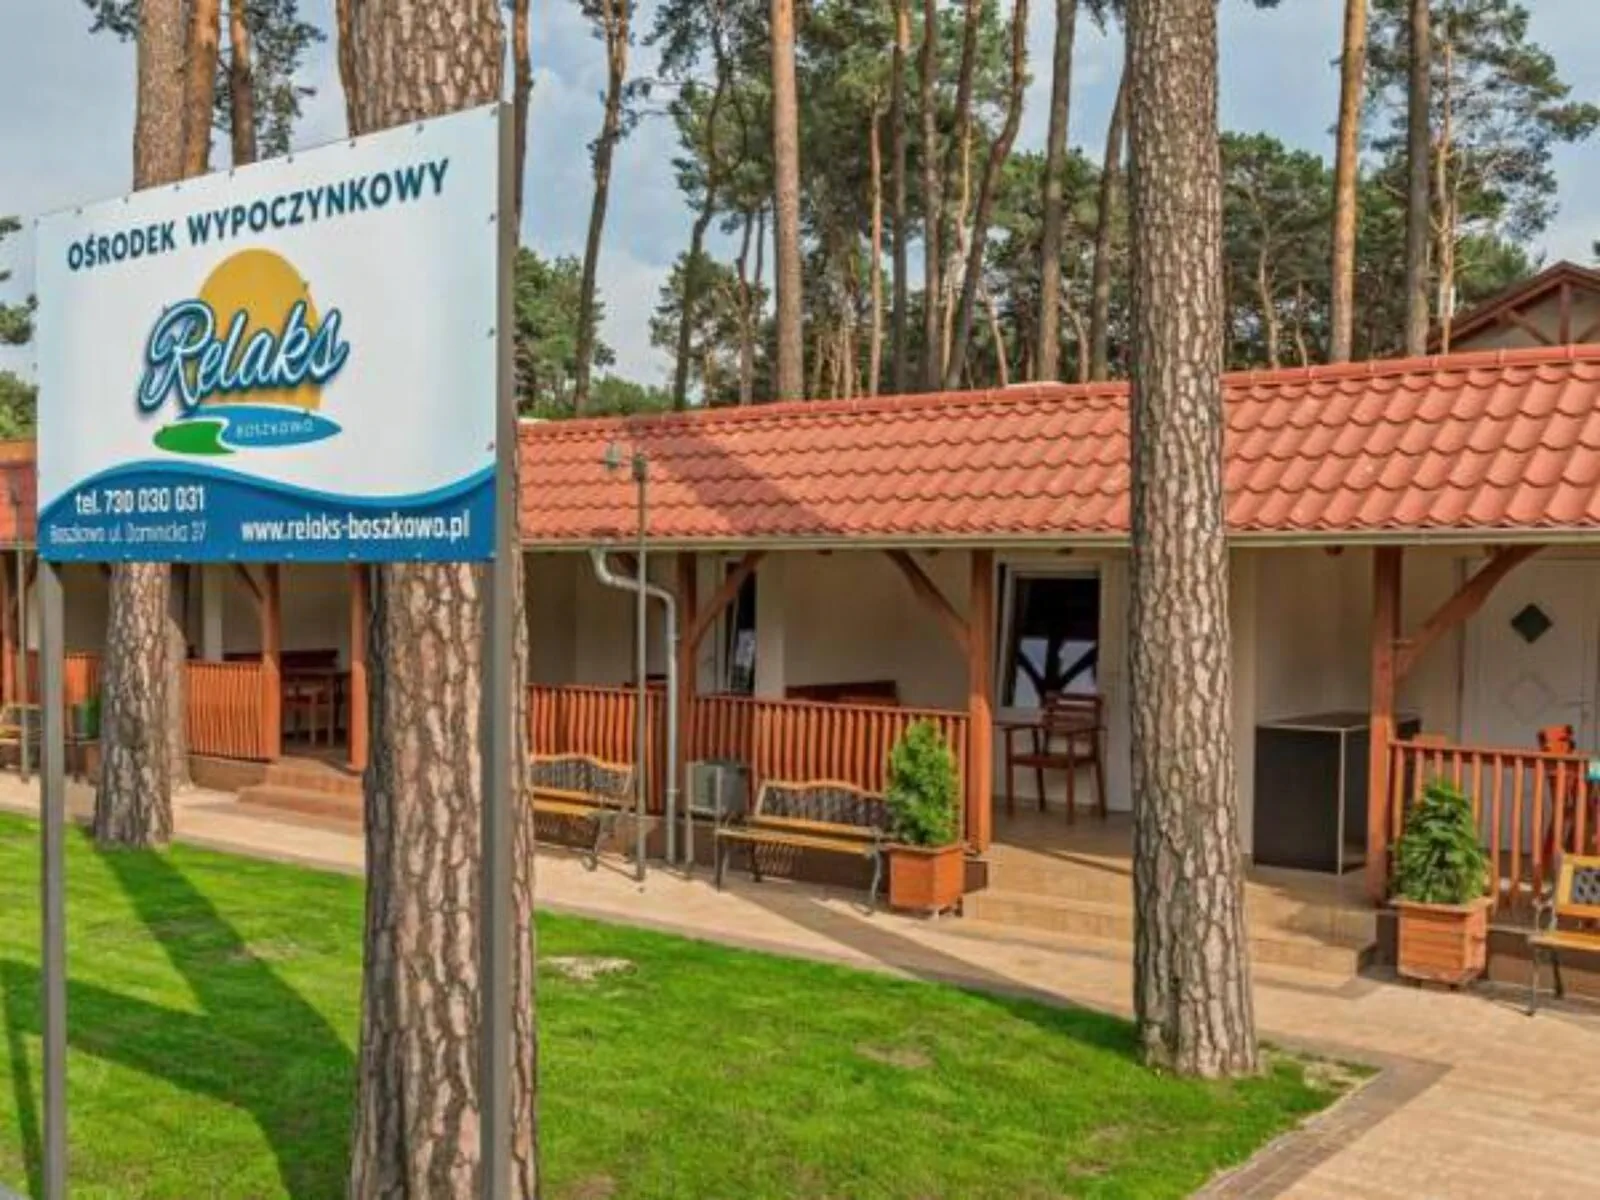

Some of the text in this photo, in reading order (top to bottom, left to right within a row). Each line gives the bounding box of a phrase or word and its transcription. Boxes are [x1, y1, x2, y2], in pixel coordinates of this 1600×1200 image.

[67, 158, 450, 272] OŚRODEK WYPOCZYNKOWY
[137, 299, 350, 414] Relaks
[104, 489, 134, 514] 730
[137, 487, 170, 512] 030
[175, 485, 205, 511] 031
[241, 508, 470, 544] www.relaks-boszkowo.pl
